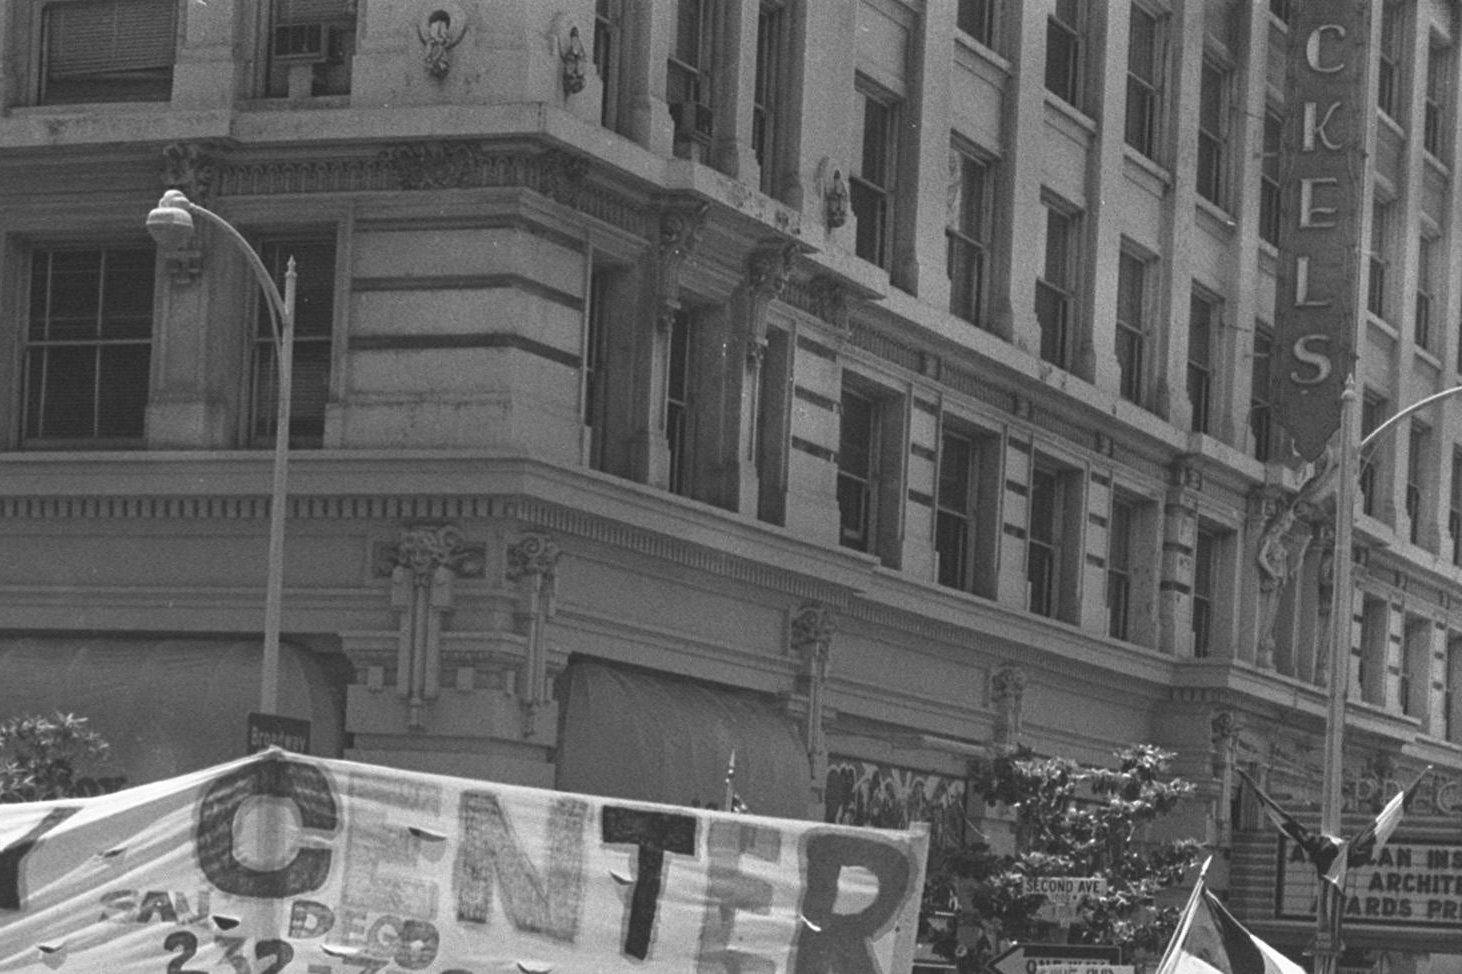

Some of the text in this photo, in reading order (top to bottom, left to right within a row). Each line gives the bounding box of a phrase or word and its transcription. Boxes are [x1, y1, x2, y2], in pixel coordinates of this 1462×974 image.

[251, 726, 306, 752] Broadway
[1026, 880, 1100, 894] SECOND AVE
[1347, 896, 1412, 918] ARDS
[1427, 899, 1462, 919] PR
